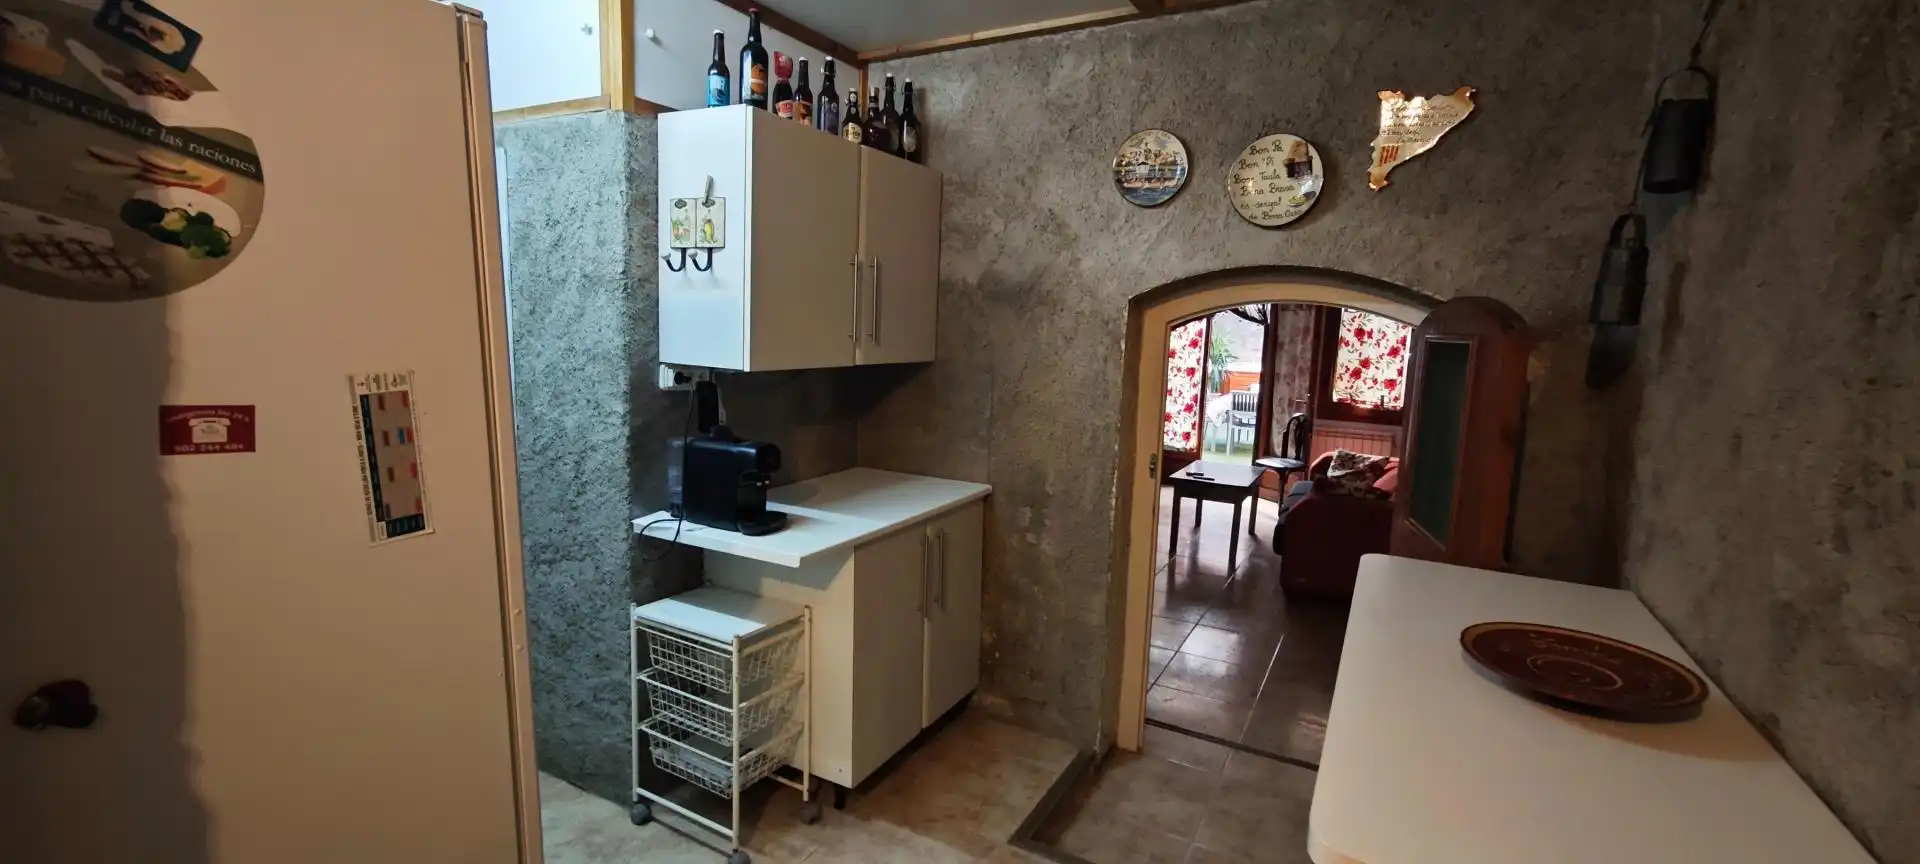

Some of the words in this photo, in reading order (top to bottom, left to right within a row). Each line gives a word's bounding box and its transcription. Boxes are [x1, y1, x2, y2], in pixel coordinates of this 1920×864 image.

[29, 85, 73, 111] para
[81, 103, 155, 137] calcular
[160, 127, 183, 148] las
[188, 142, 257, 174] raciones
[1249, 145, 1269, 156] Bon
[1238, 159, 1258, 170] Bon
